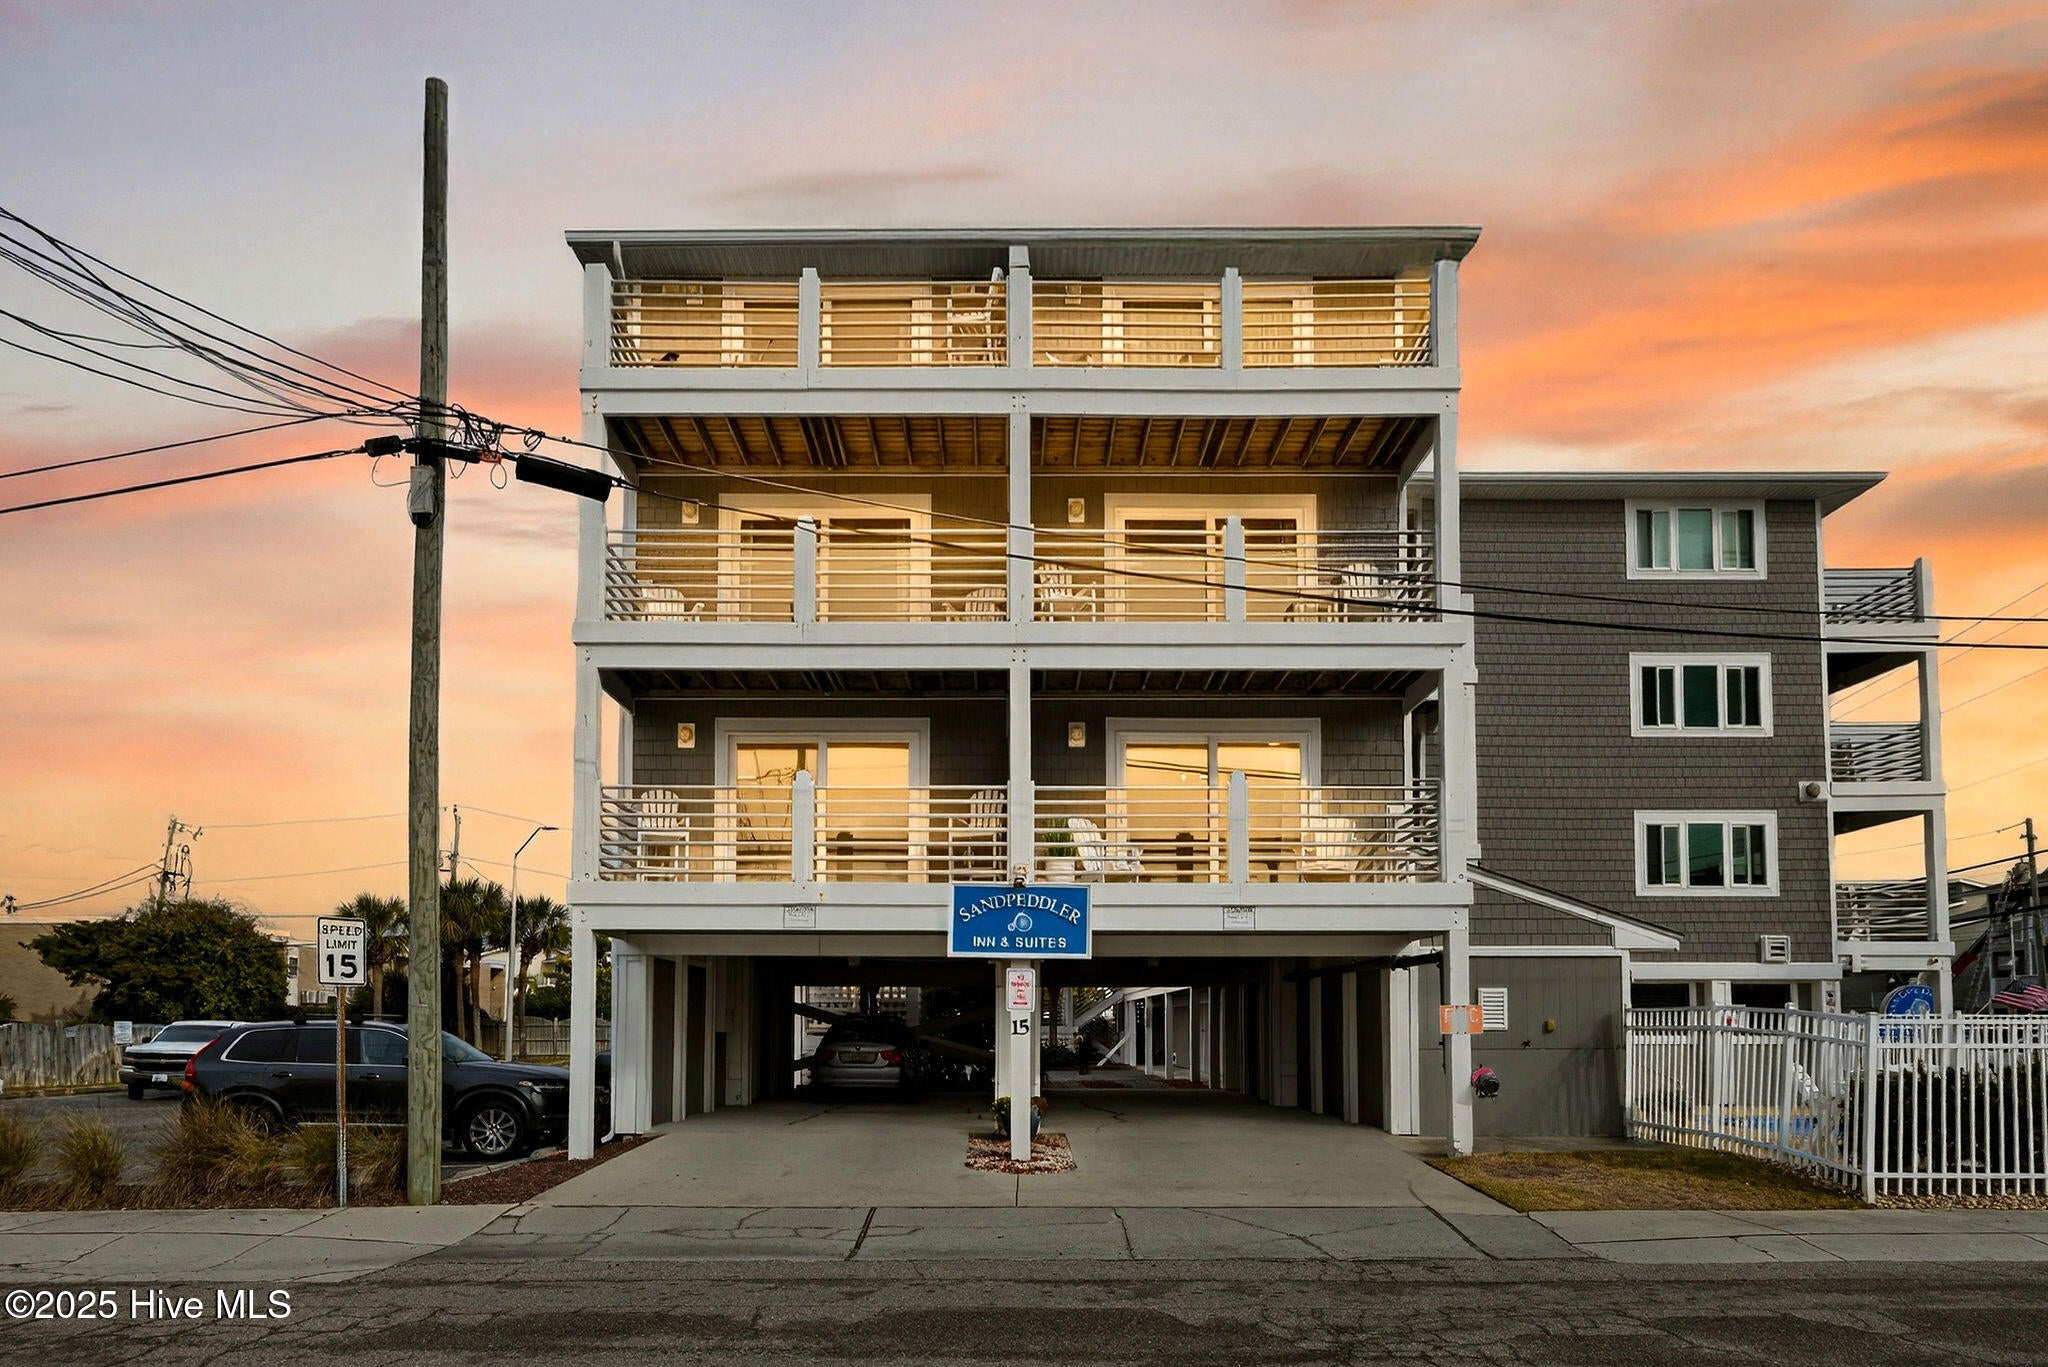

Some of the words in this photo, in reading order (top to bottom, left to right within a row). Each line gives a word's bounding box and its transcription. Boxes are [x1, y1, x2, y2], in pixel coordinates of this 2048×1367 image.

[959, 893, 1081, 925] SANDPEDDLER
[321, 924, 363, 937] SPEED
[326, 938, 358, 950] LIMIT
[973, 935, 996, 948] INN
[1000, 936, 1009, 948] &
[1015, 936, 1067, 949] SUITES
[326, 953, 358, 979] 15
[1011, 1018, 1030, 1036] 15
